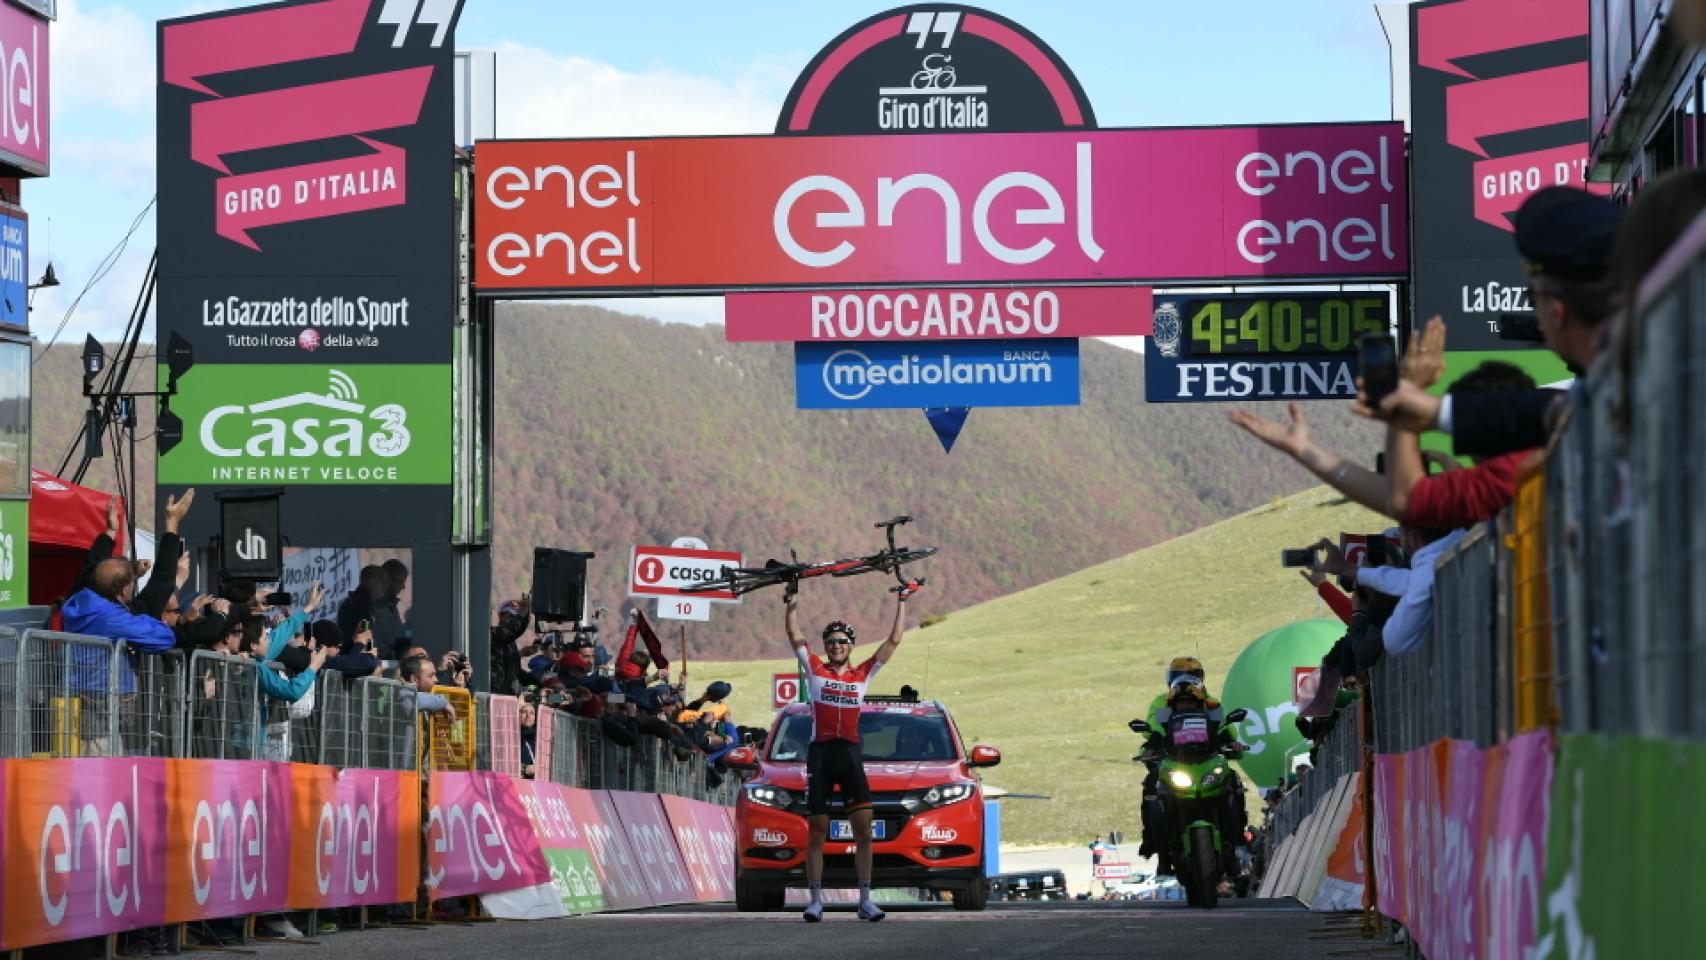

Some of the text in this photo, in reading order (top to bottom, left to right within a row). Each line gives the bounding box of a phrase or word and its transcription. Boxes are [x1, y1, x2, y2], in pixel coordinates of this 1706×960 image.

[879, 96, 988, 129] Giro d'Italia
[224, 166, 396, 215] GIRO D'ITALIA
[486, 150, 641, 210] enel
[1236, 136, 1394, 196] enel
[1482, 166, 1541, 199] GIRO
[773, 141, 1105, 268] enel
[486, 217, 642, 277] enel
[1236, 203, 1396, 264] enel
[310, 296, 355, 326] dello
[356, 296, 409, 332] Sport
[811, 291, 1060, 338] ROCCARASO
[1486, 281, 1534, 313] Gazz
[227, 334, 259, 347] Tutto
[270, 336, 296, 347] rosa
[323, 334, 353, 347] della
[355, 335, 379, 347] vita
[1191, 299, 1382, 353] 4:40:05
[833, 353, 1052, 389] mediolanum
[1003, 350, 1051, 361] BANCA
[1176, 361, 1360, 398] FESTINA
[200, 403, 411, 458] Casa3
[212, 466, 397, 480] INTERNET VELOCE
[676, 603, 692, 615] 10
[40, 764, 141, 926] enel
[191, 767, 268, 906] enel
[316, 776, 379, 896] enel
[424, 776, 522, 888] enel
